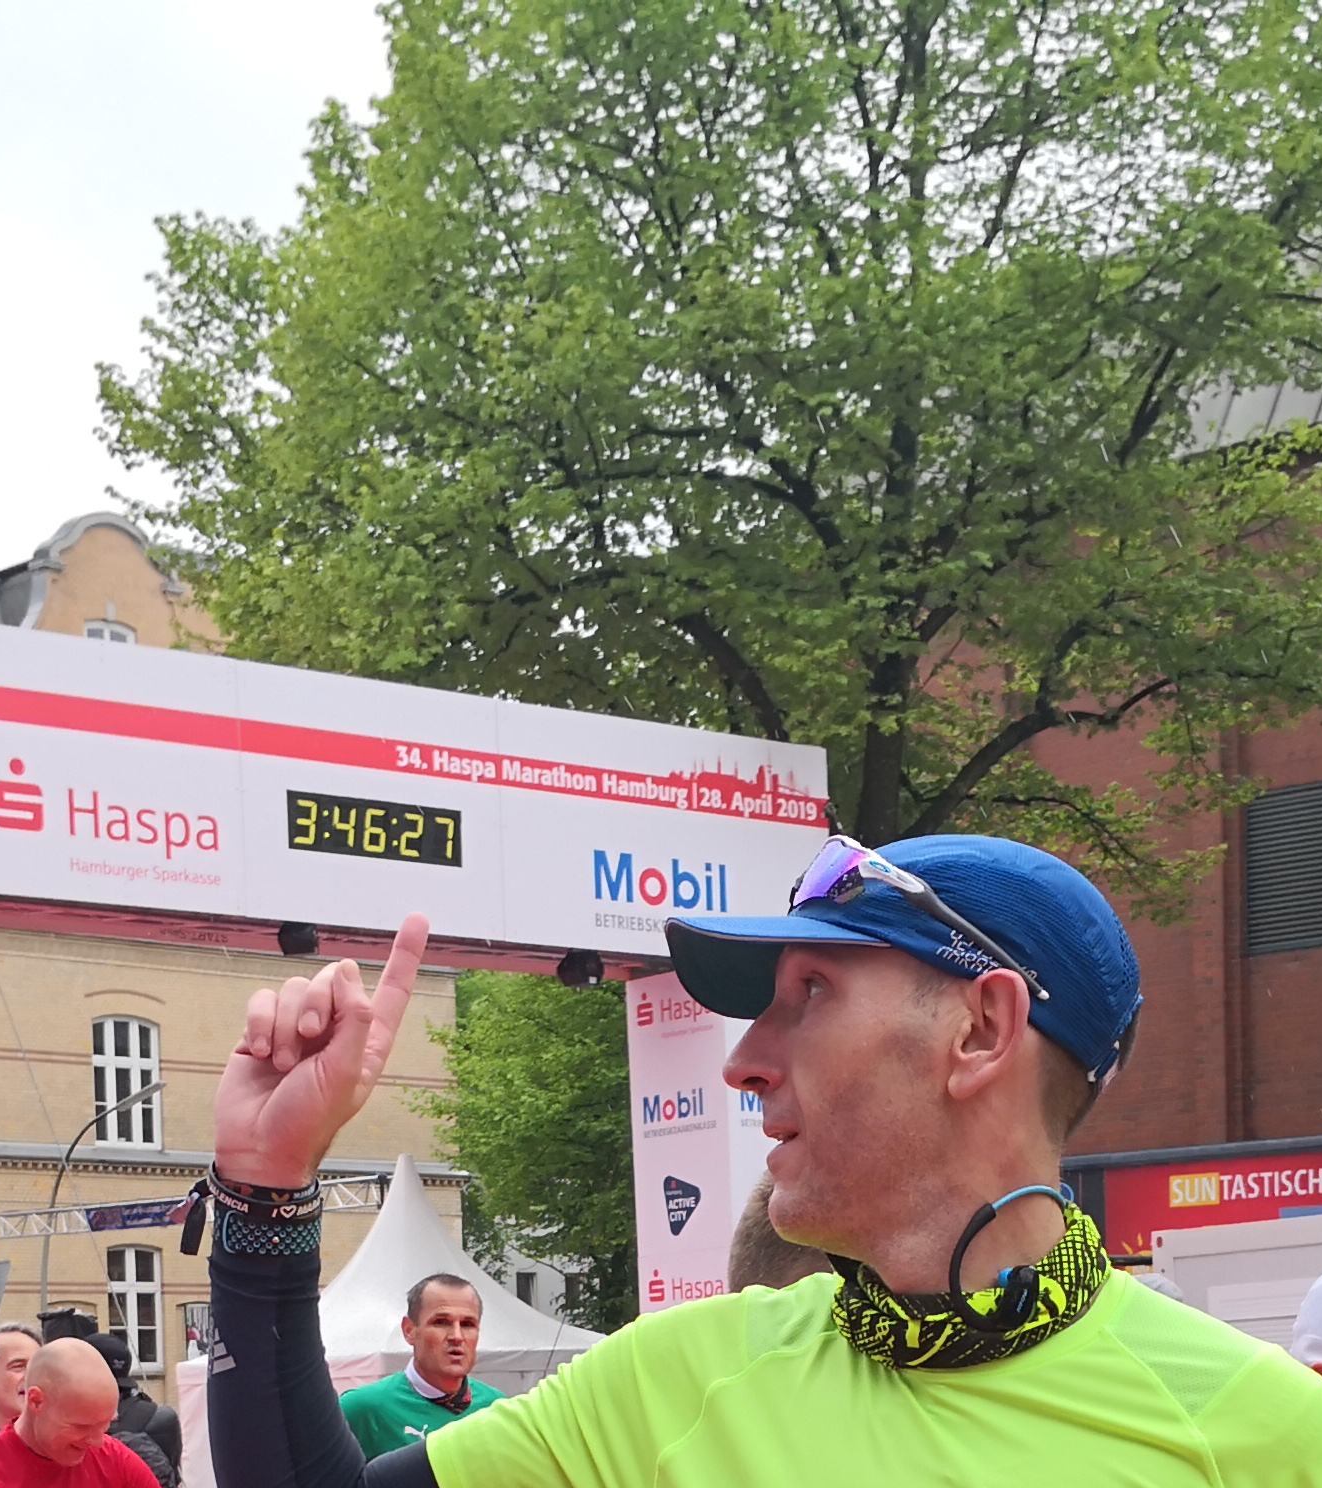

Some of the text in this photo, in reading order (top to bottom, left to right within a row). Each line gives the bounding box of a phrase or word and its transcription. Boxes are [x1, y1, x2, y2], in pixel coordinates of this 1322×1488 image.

[432, 753, 497, 783] Haspa
[501, 758, 598, 791] Marathon
[602, 772, 689, 809] Hamburg
[731, 790, 775, 818] April
[777, 797, 818, 822] 2019
[68, 787, 220, 860] Haspa
[293, 799, 455, 860] 3:46:27
[70, 858, 222, 886] Hamburger Sparkasse
[593, 849, 728, 913] Mobil
[642, 1087, 704, 1125] Mobil
[668, 1196, 696, 1210] ACTIVE
[669, 1209, 687, 1223] CITY
[671, 1277, 724, 1300] Haspa
